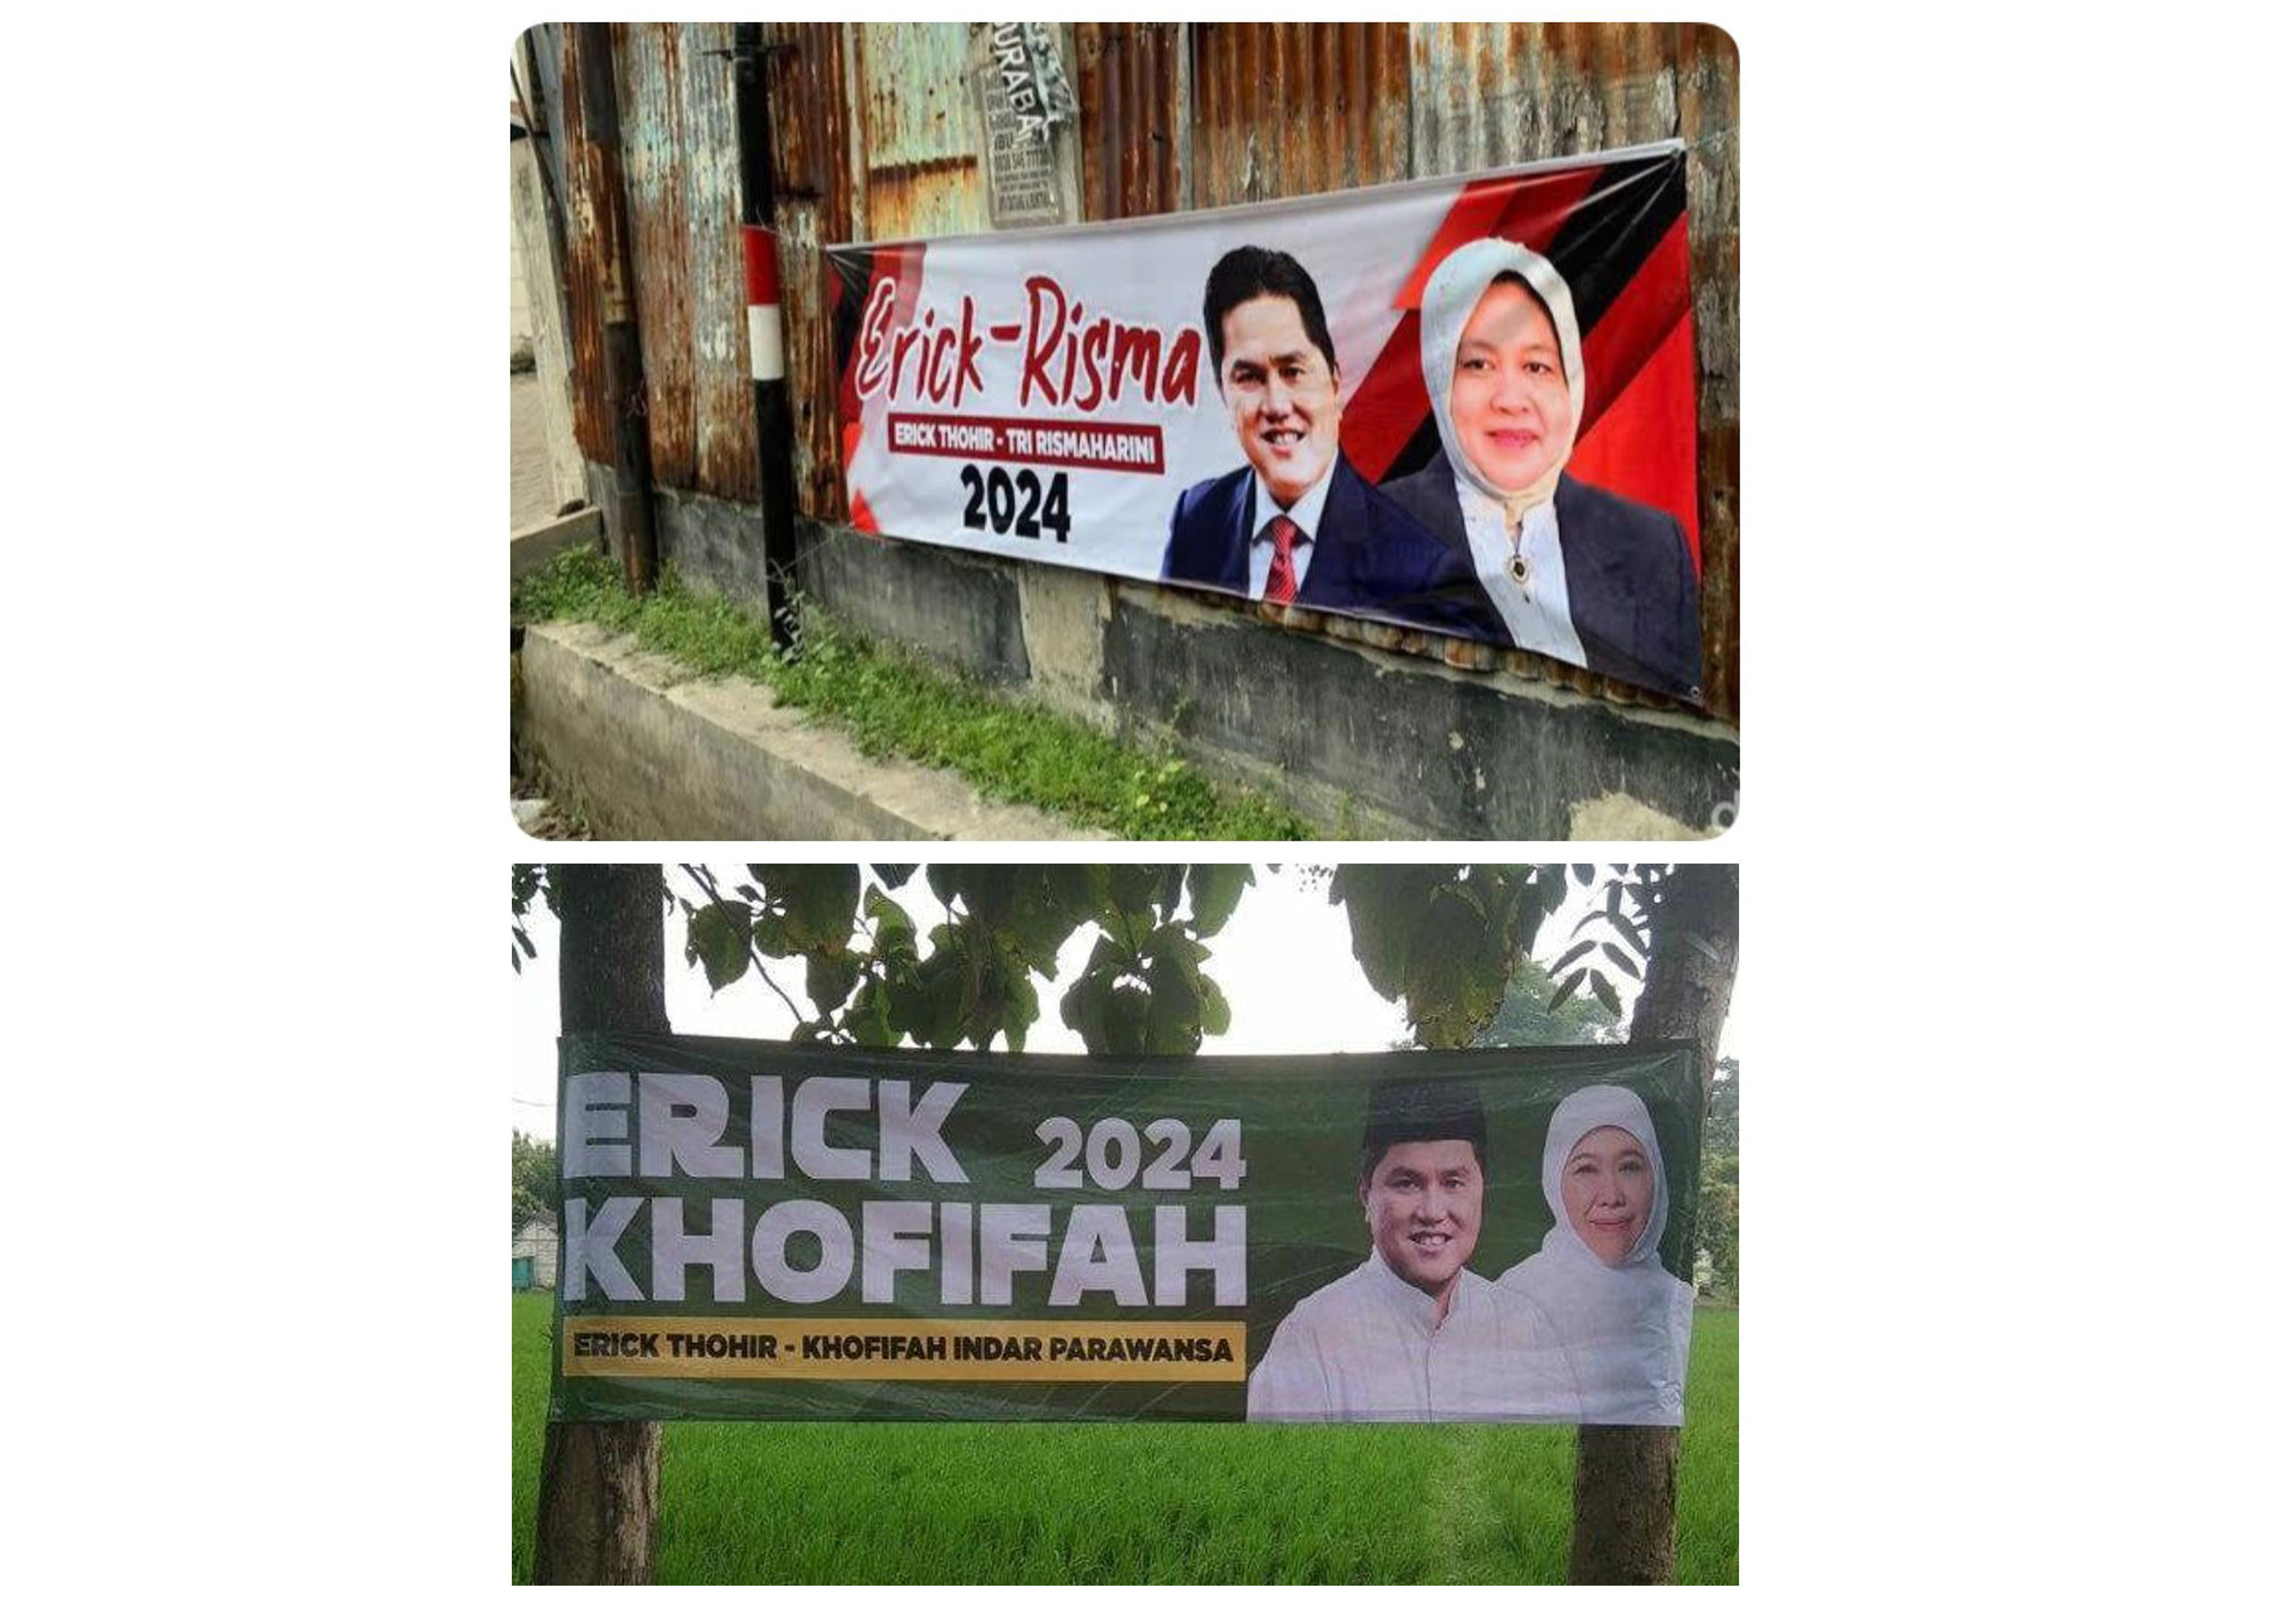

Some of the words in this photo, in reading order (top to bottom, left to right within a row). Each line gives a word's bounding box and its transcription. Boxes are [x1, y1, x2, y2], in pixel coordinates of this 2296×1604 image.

[992, 22, 1043, 142] URABA
[857, 275, 1202, 412] Erick-Risma
[894, 422, 935, 447] ERICK
[938, 426, 995, 452] THOHIR
[1006, 429, 1032, 454] TRI
[1035, 431, 1155, 464] RISMAHARINI
[960, 464, 1071, 543] 2024
[563, 1071, 970, 1183] ERICK
[1033, 1116, 1246, 1190] 2024
[563, 1196, 1247, 1307] KHOFIFAH
[573, 1332, 660, 1358] ERICK
[666, 1333, 778, 1360] THOHIR
[802, 1334, 947, 1362] KHOFIFAH
[954, 1336, 1043, 1362] INDAR
[1049, 1336, 1234, 1363] PARAWANSA
